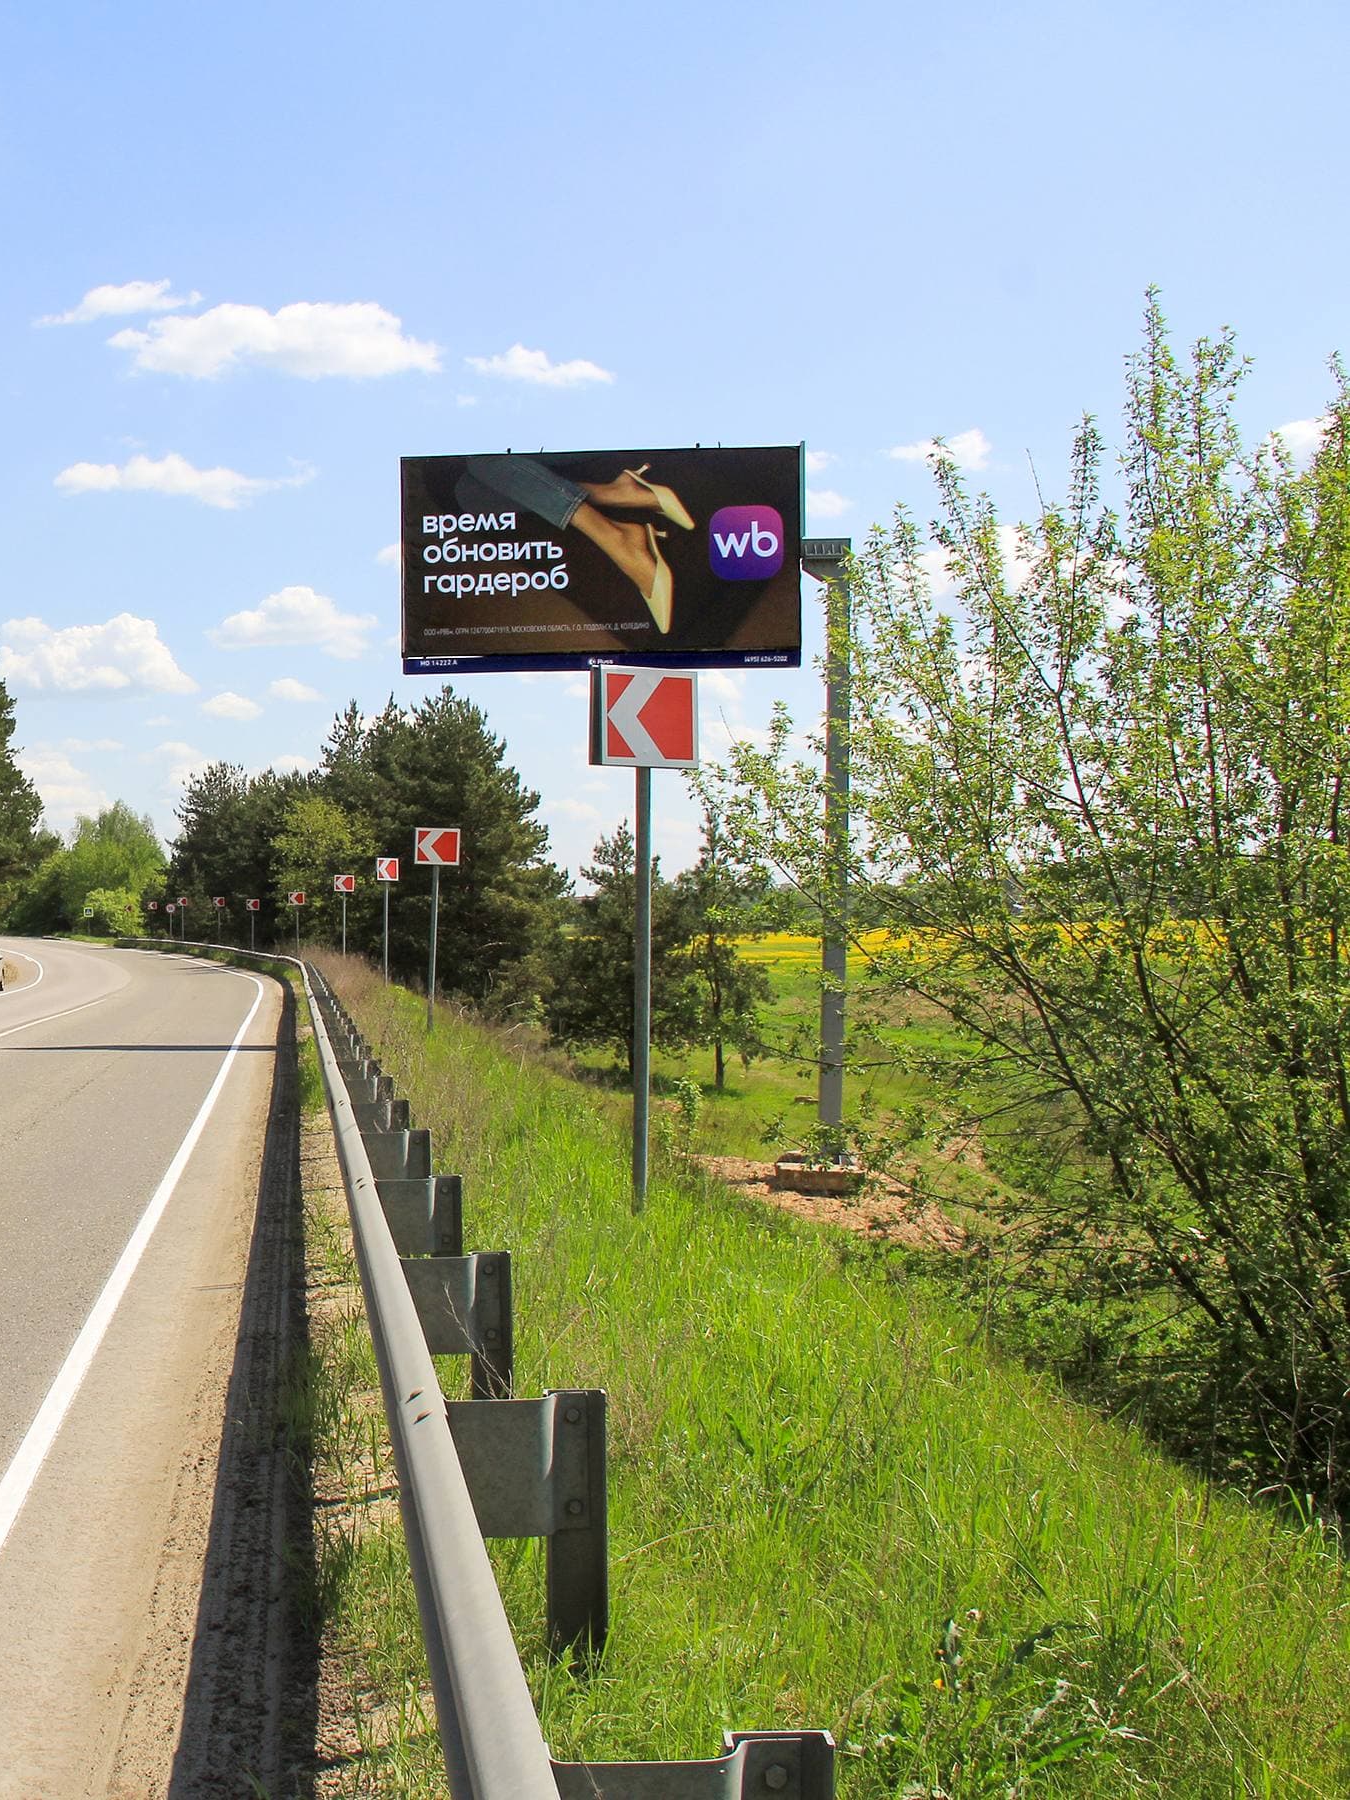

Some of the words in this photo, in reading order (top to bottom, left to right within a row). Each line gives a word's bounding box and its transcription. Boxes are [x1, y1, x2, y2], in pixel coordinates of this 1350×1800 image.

[422, 512, 516, 539] время
[713, 520, 779, 558] wb
[423, 537, 563, 564] обновить
[423, 563, 569, 599] гардероб
